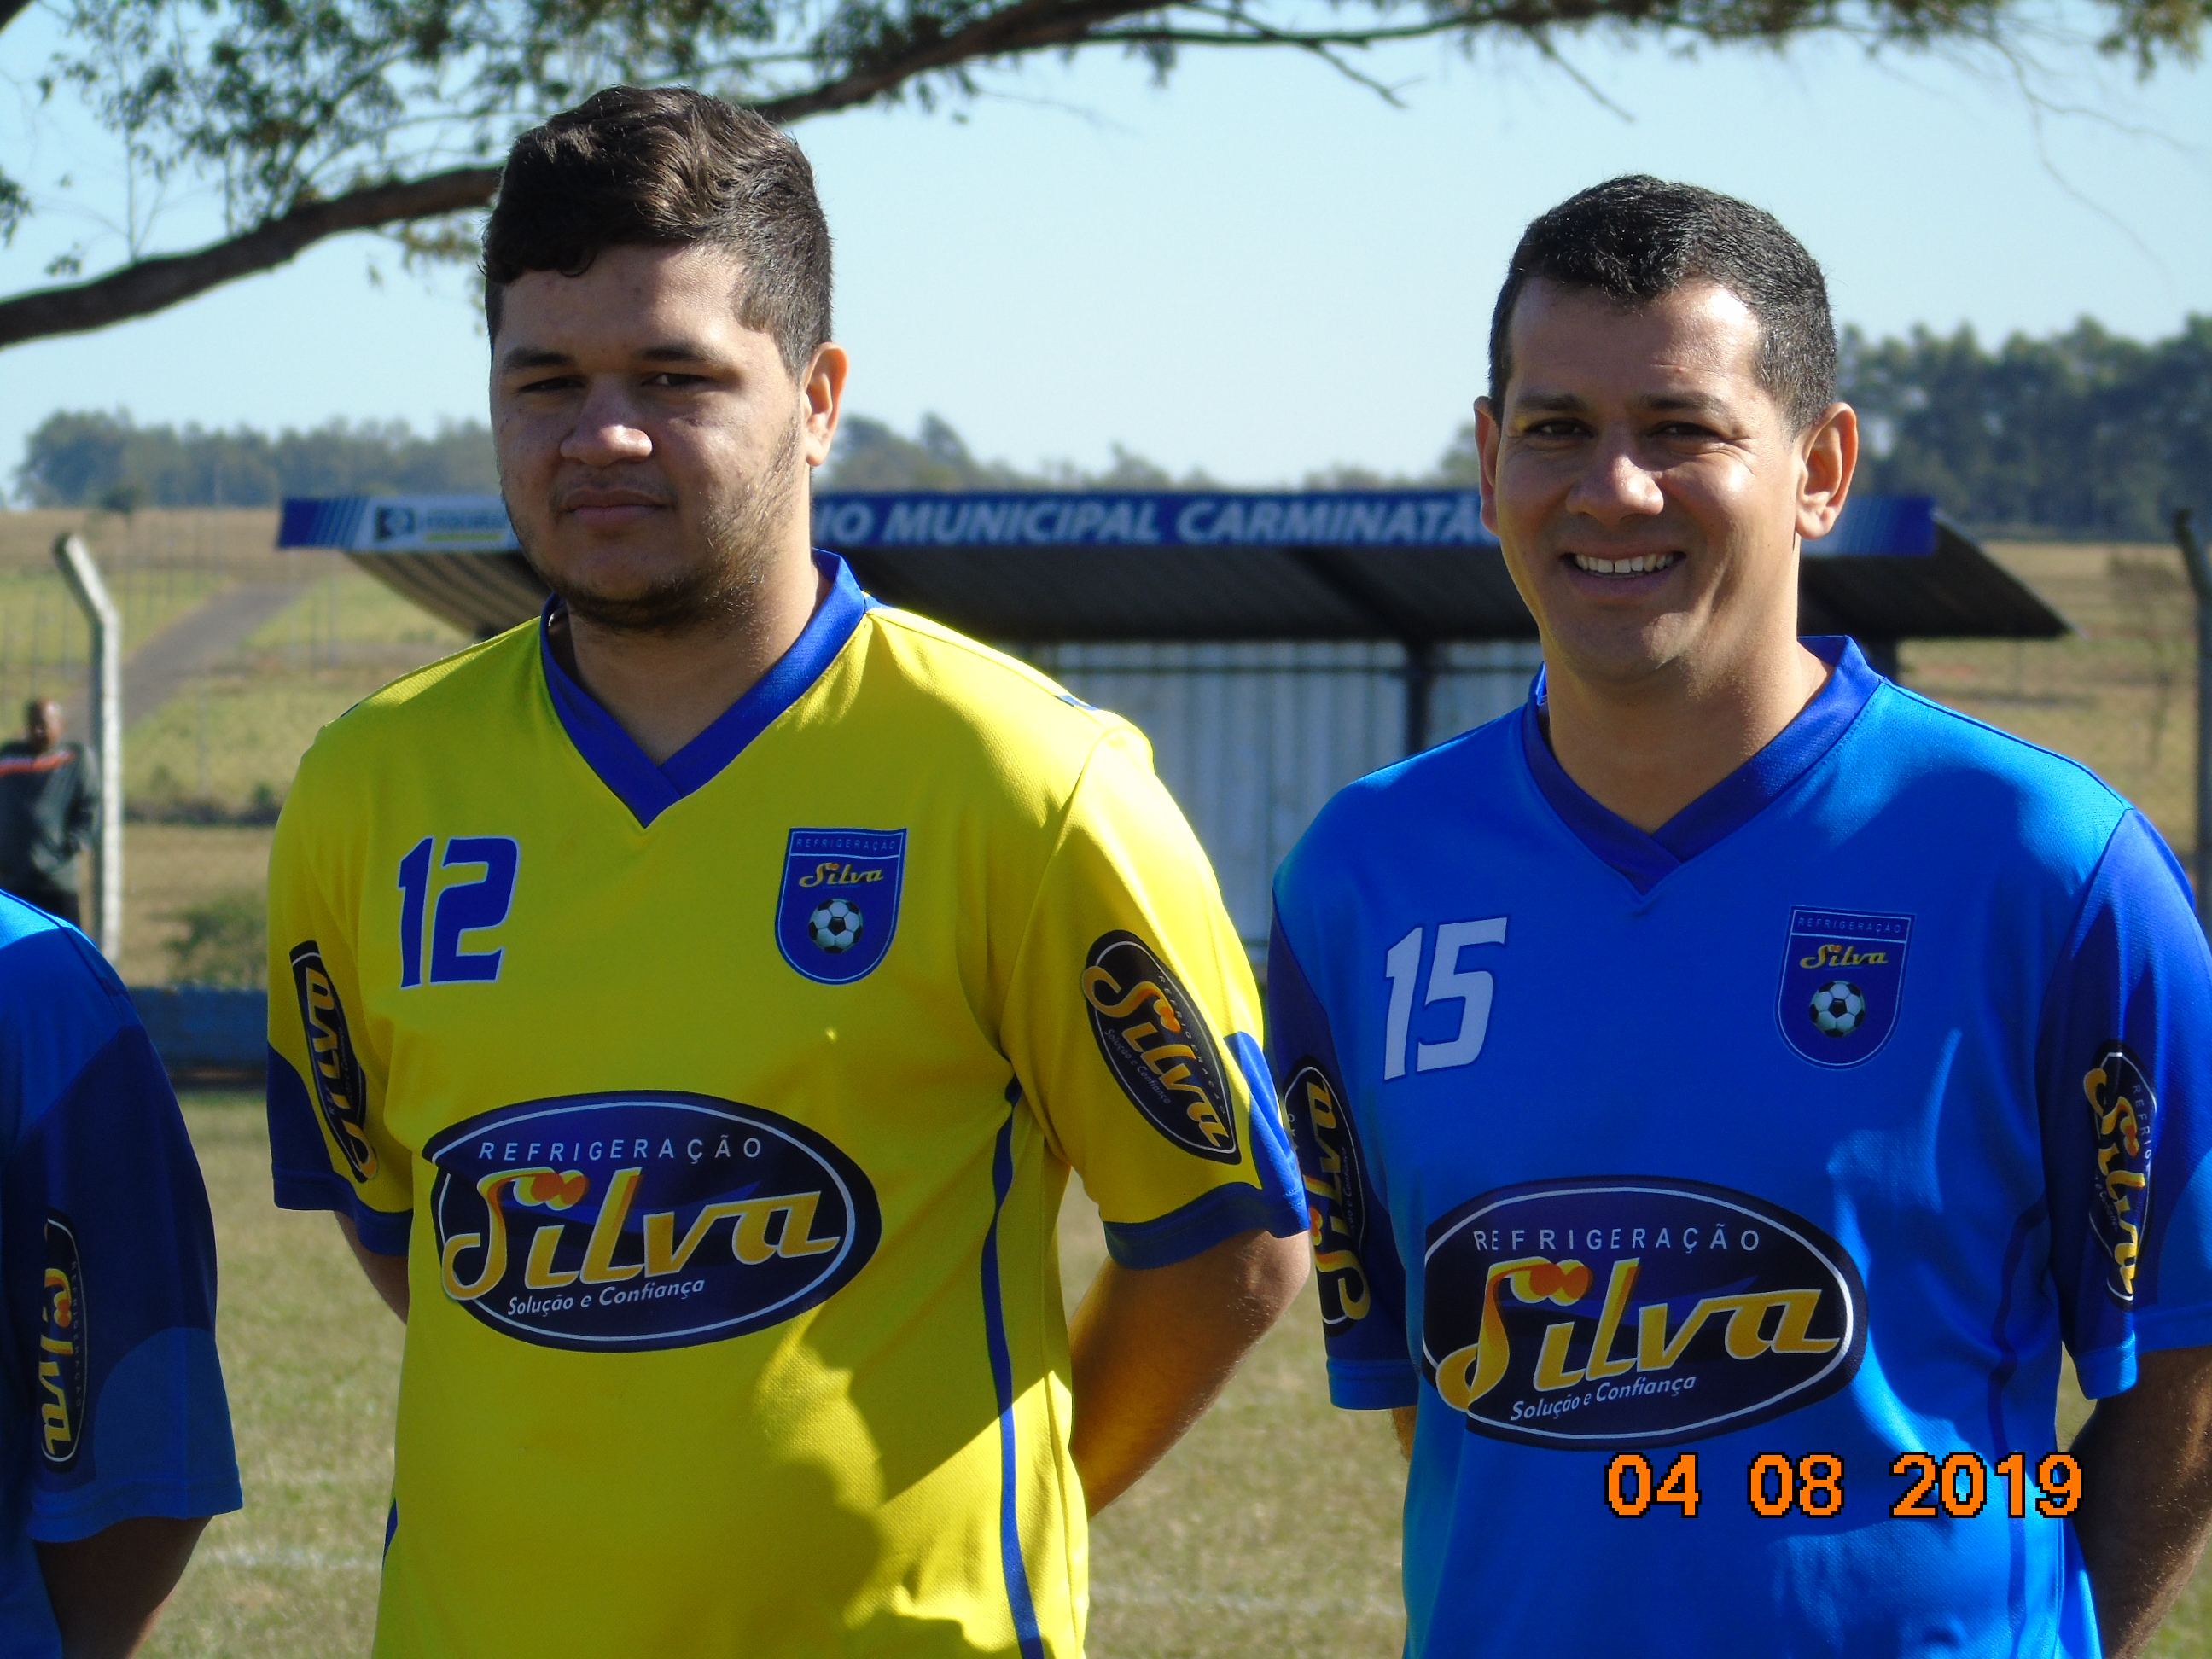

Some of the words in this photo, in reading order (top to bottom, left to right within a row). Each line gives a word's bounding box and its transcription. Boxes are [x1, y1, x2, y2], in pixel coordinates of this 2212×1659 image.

[813, 502, 874, 543] IO
[882, 502, 1161, 543] MUNICIPAL
[796, 838, 896, 851] REFRIGERAÇÃO
[799, 862, 884, 888] Silva
[398, 836, 520, 990] 12
[1798, 917, 1901, 934] REFRIGERAÇÃO
[1800, 944, 1889, 969] Silva
[1383, 917, 1508, 1080] 15
[1081, 965, 1230, 1148] Silva
[479, 1135, 761, 1164] REFRIGERAÇÃO
[1302, 1081, 1371, 1320] Silva
[442, 1166, 841, 1301] Silva
[1473, 1223, 1760, 1254] REFRIGERAÇÃO
[508, 1294, 574, 1318] Solução
[580, 1295, 591, 1307] e
[599, 1279, 705, 1306] Confiança
[38, 1223, 74, 1455] lva
[1435, 1256, 1842, 1412] Silva
[1510, 1394, 1580, 1421] Solução
[1583, 1392, 1592, 1406] e
[1596, 1377, 1697, 1402] Confiança
